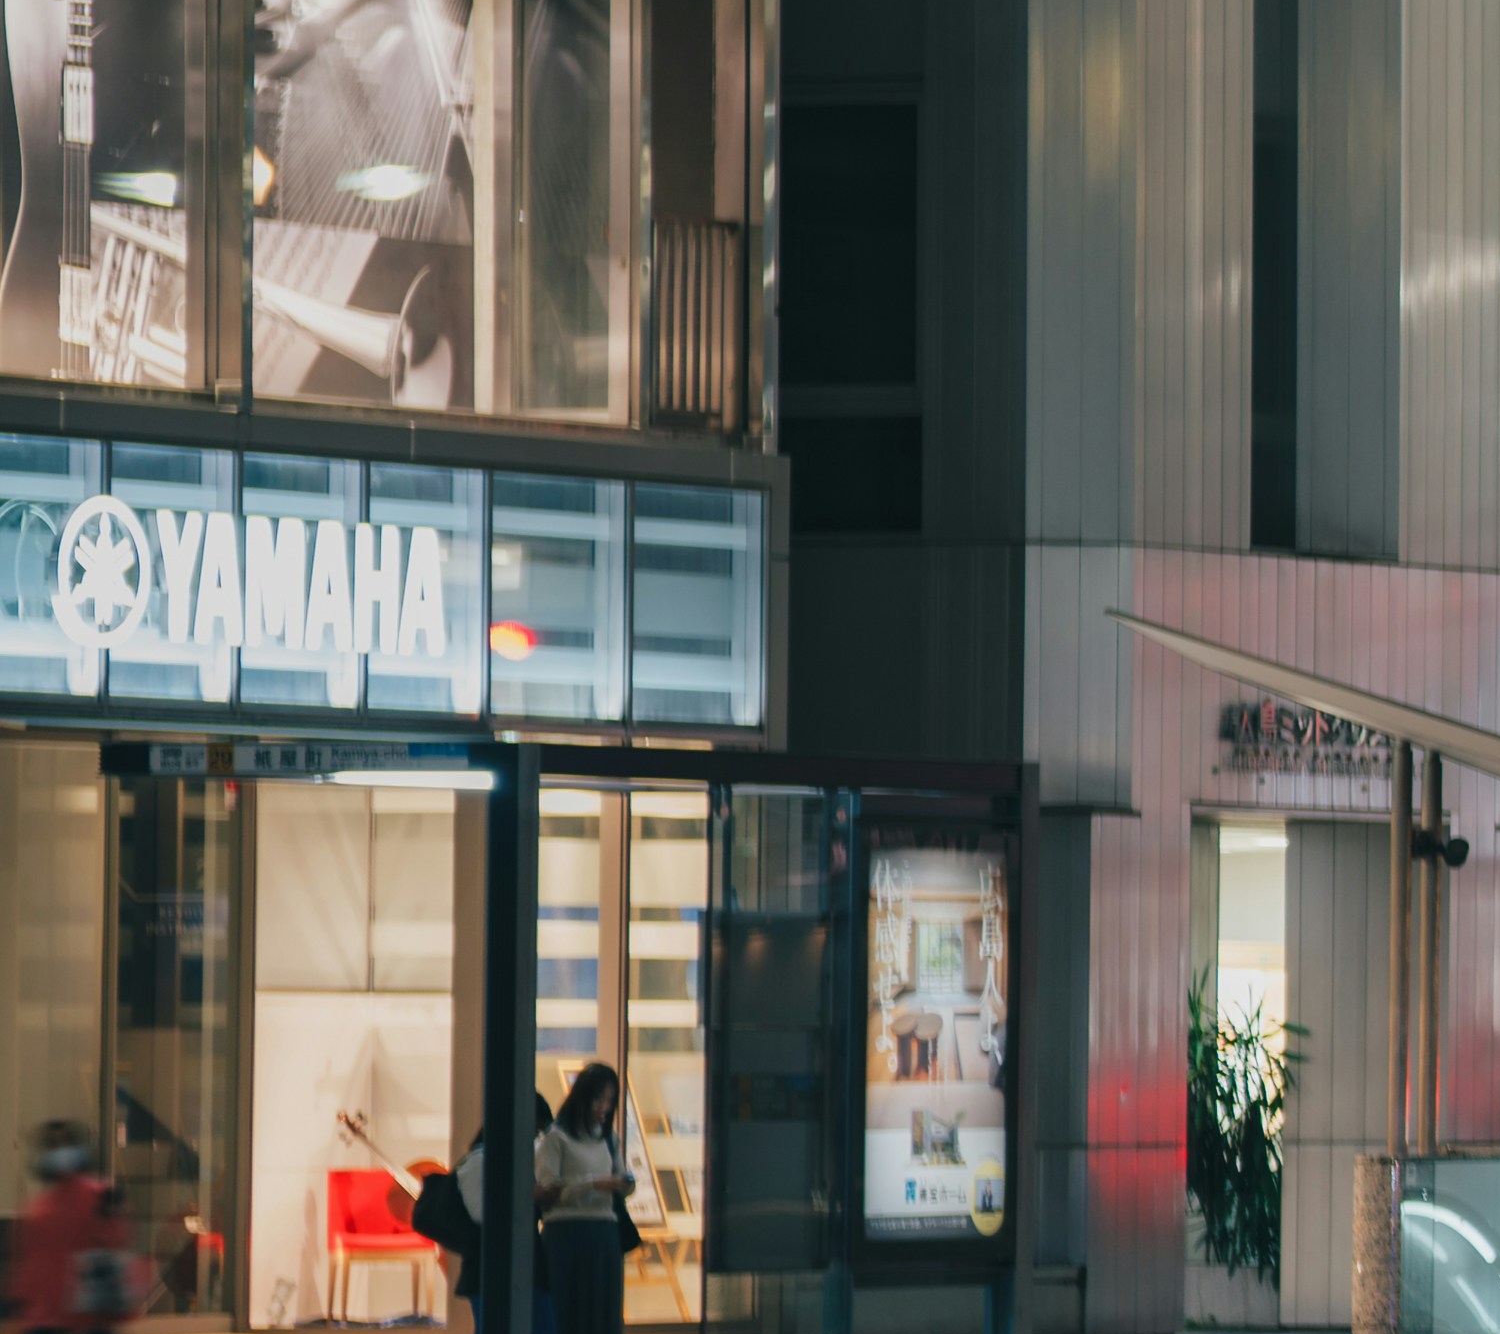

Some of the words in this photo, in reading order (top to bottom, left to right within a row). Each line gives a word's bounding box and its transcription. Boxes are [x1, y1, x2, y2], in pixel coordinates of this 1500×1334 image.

[156, 509, 447, 657] YAMAHA
[254, 748, 323, 769] 紙屋町
